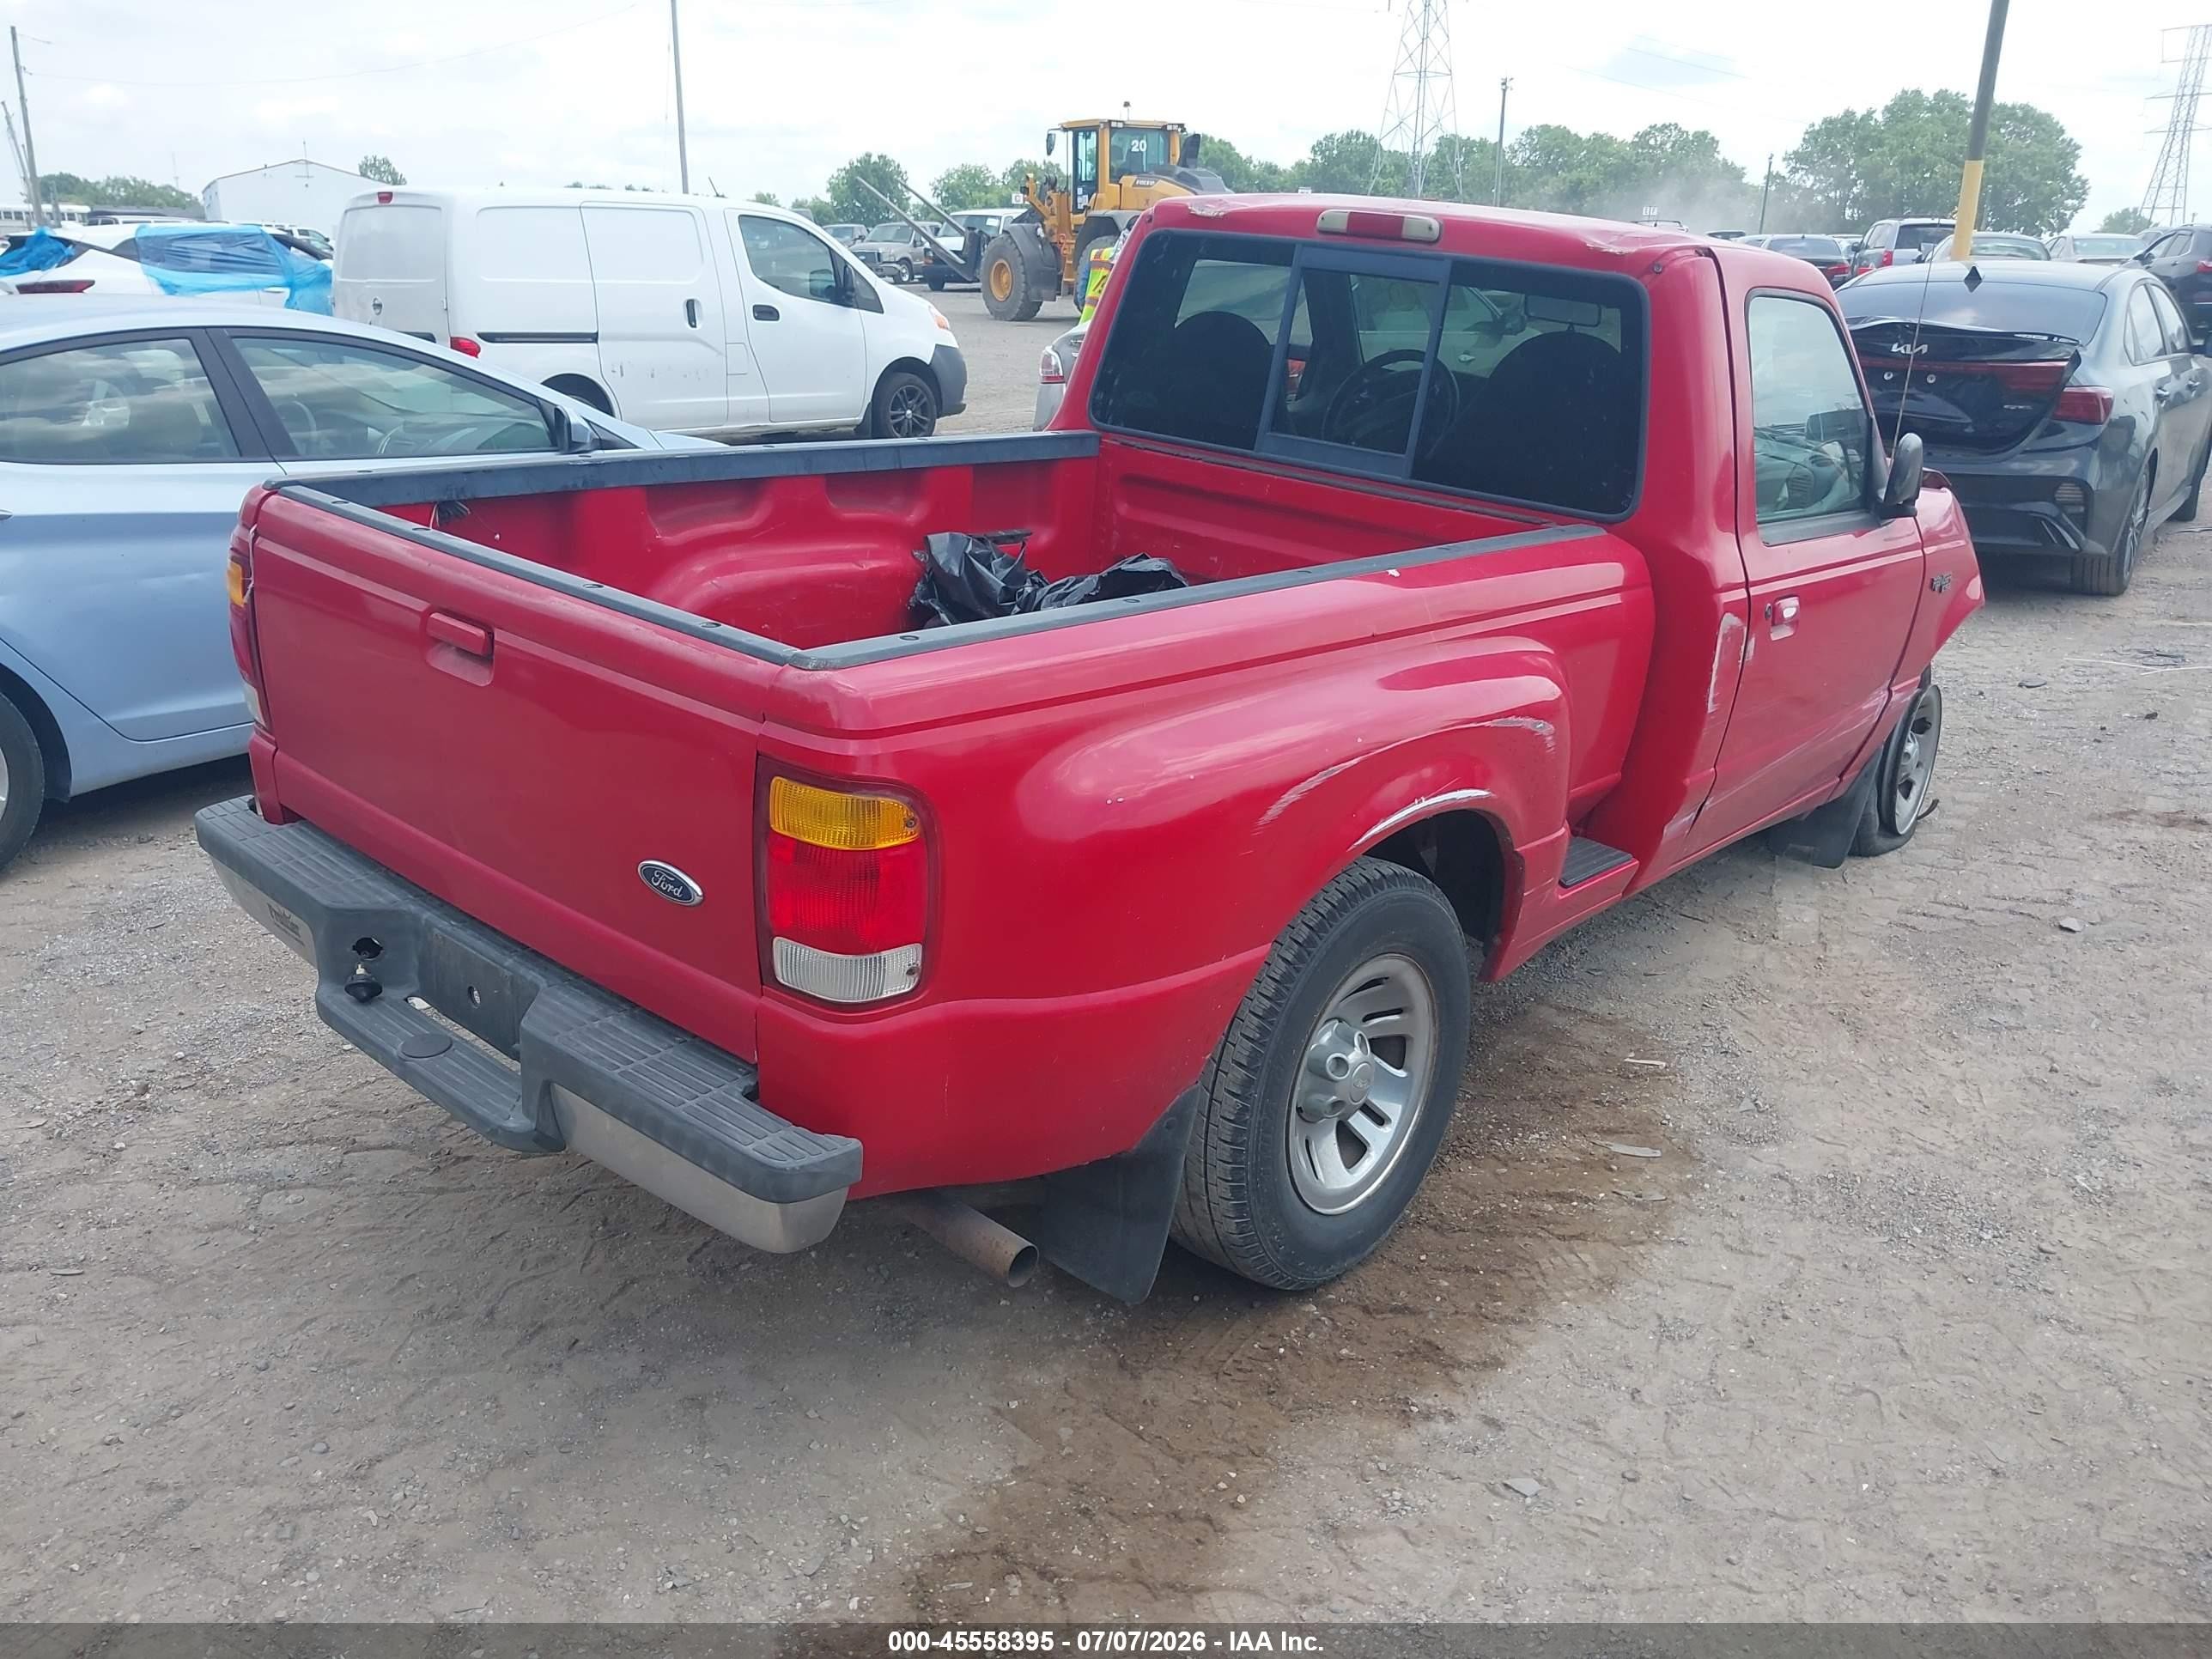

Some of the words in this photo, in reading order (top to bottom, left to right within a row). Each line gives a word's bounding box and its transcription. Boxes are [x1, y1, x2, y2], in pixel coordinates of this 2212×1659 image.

[1131, 140, 1147, 152] 20
[1891, 343, 1928, 355] KIA
[651, 870, 684, 897] Ford
